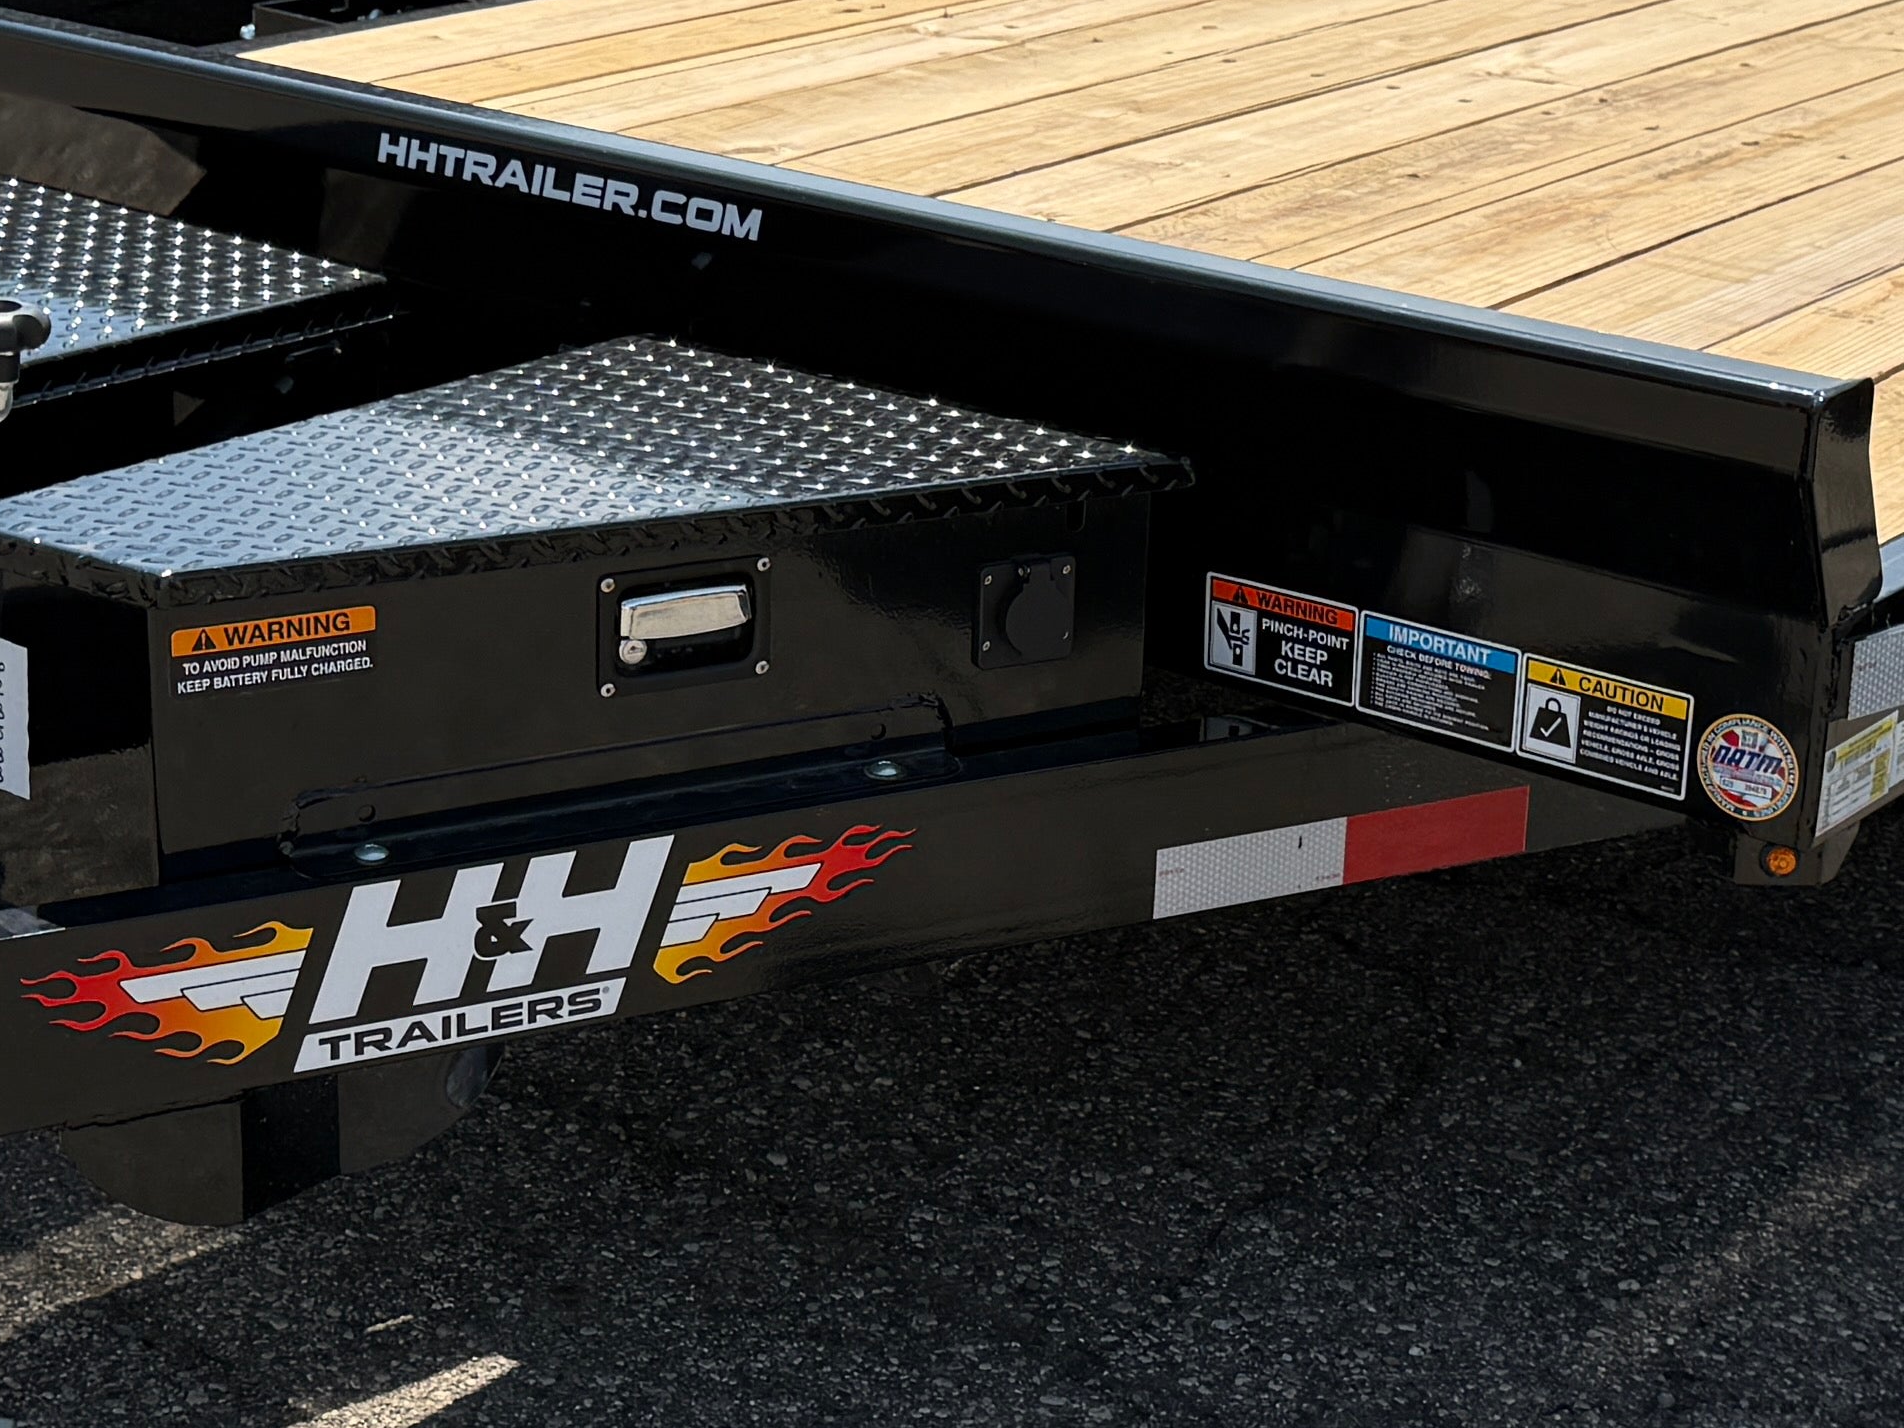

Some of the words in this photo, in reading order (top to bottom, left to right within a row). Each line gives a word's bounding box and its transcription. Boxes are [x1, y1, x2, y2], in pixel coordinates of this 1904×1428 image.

[377, 132, 763, 242] HHTRAILER.COM
[1255, 590, 1339, 626] WARNING
[223, 612, 351, 647] WARNING
[1261, 617, 1351, 651] PINCH-POINT
[1389, 624, 1492, 666] IMPORTANT
[182, 661, 200, 676] TO
[202, 656, 240, 674] AVOID
[242, 651, 277, 669] PUMP
[280, 639, 367, 664] MALFUNCTION
[1281, 640, 1328, 666] KEEP
[1386, 644, 1417, 660] CHECK
[1418, 652, 1453, 669] BEFORE
[177, 679, 211, 695] KEEP
[213, 670, 268, 690] BATTERY
[271, 665, 308, 682] FULLY
[311, 656, 374, 677] CHARGED.
[1273, 658, 1334, 688] CLEAR
[1578, 676, 1665, 713] CAUTION
[1606, 705, 1617, 715] DO
[1618, 708, 1633, 718] NOT
[1633, 712, 1661, 726] EXCEED
[1656, 749, 1680, 762] GROSS
[308, 834, 675, 1024] H&H
[318, 987, 602, 1061] TRAILERS
